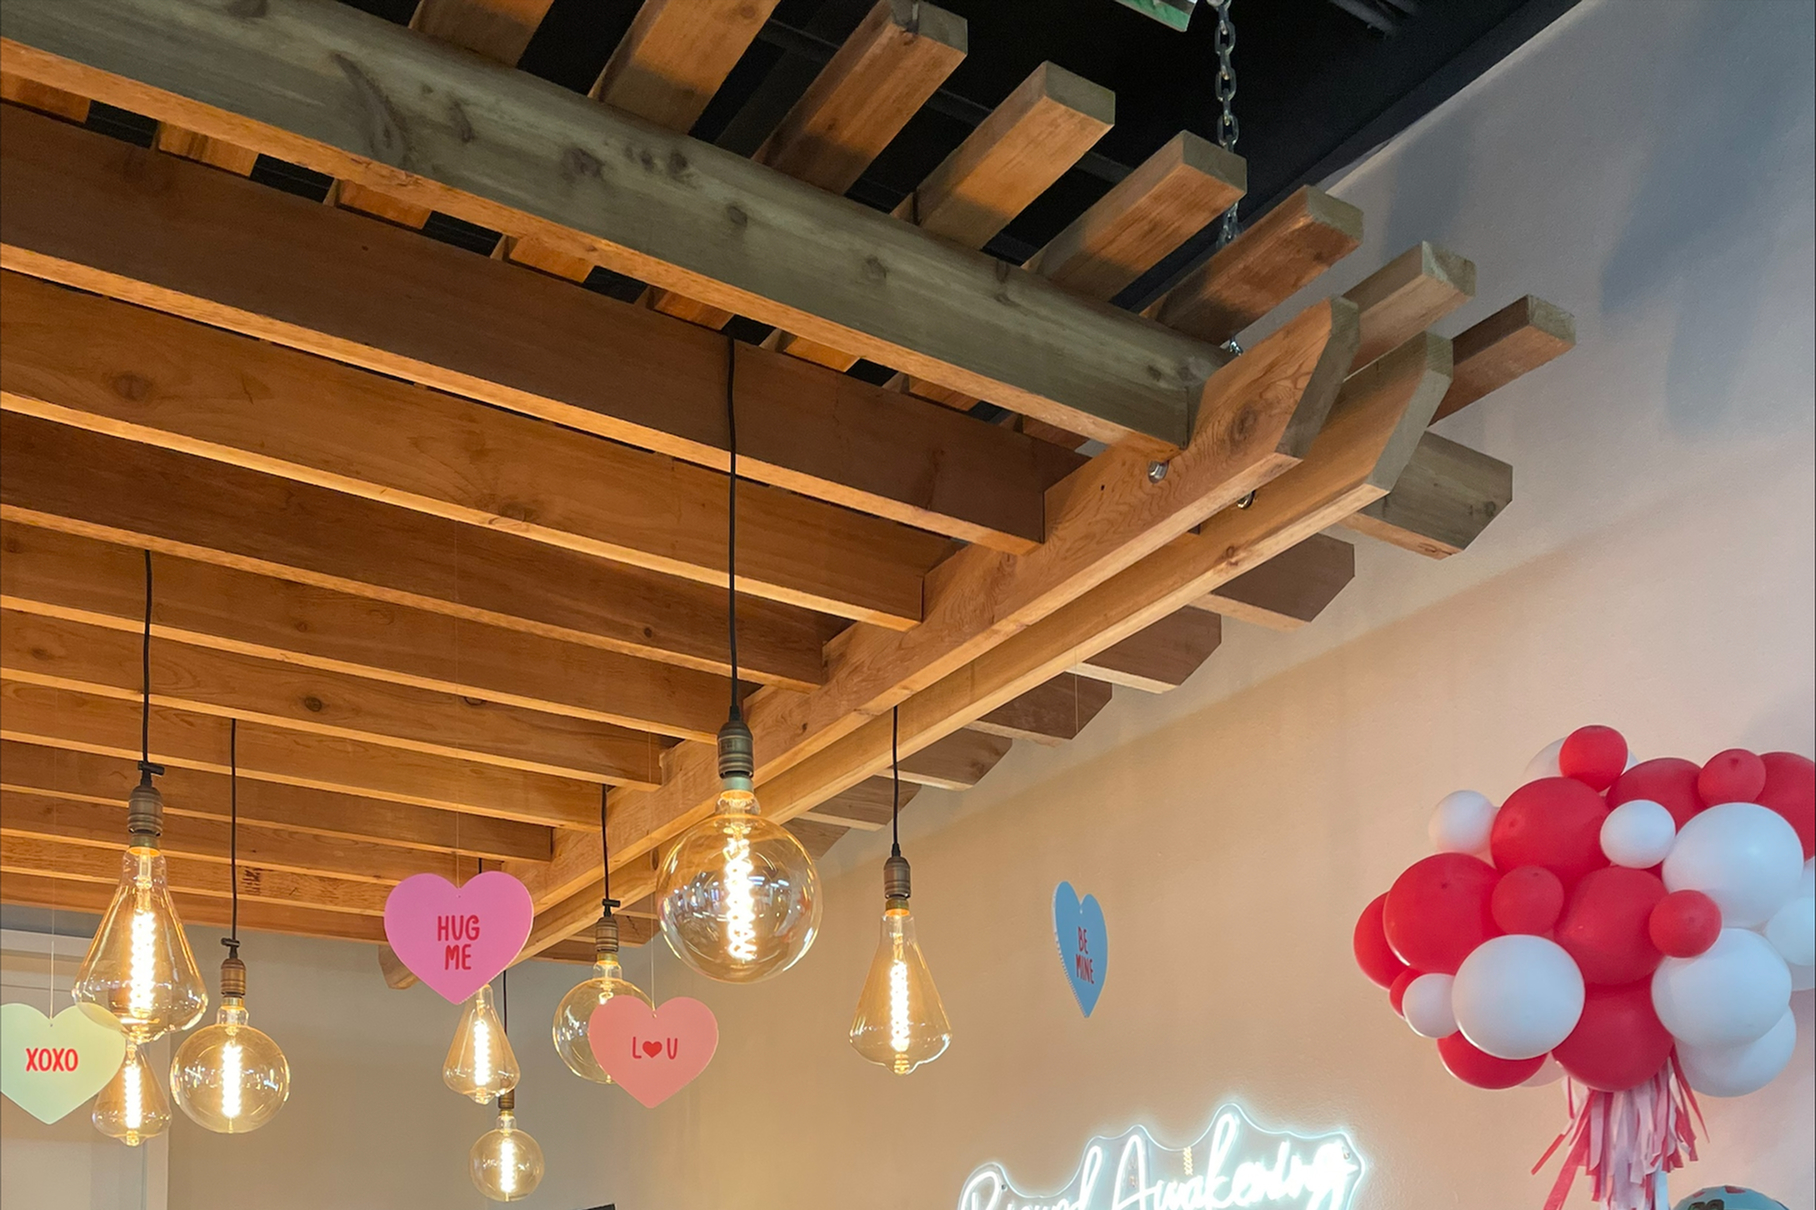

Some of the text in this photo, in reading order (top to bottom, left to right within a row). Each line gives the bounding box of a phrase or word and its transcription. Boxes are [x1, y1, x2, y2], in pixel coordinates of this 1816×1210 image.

[437, 915, 480, 941] HUG
[1077, 926, 1089, 955] BE
[444, 944, 472, 970] ME
[1075, 954, 1095, 985] MINE
[25, 1047, 79, 1072] XOXO
